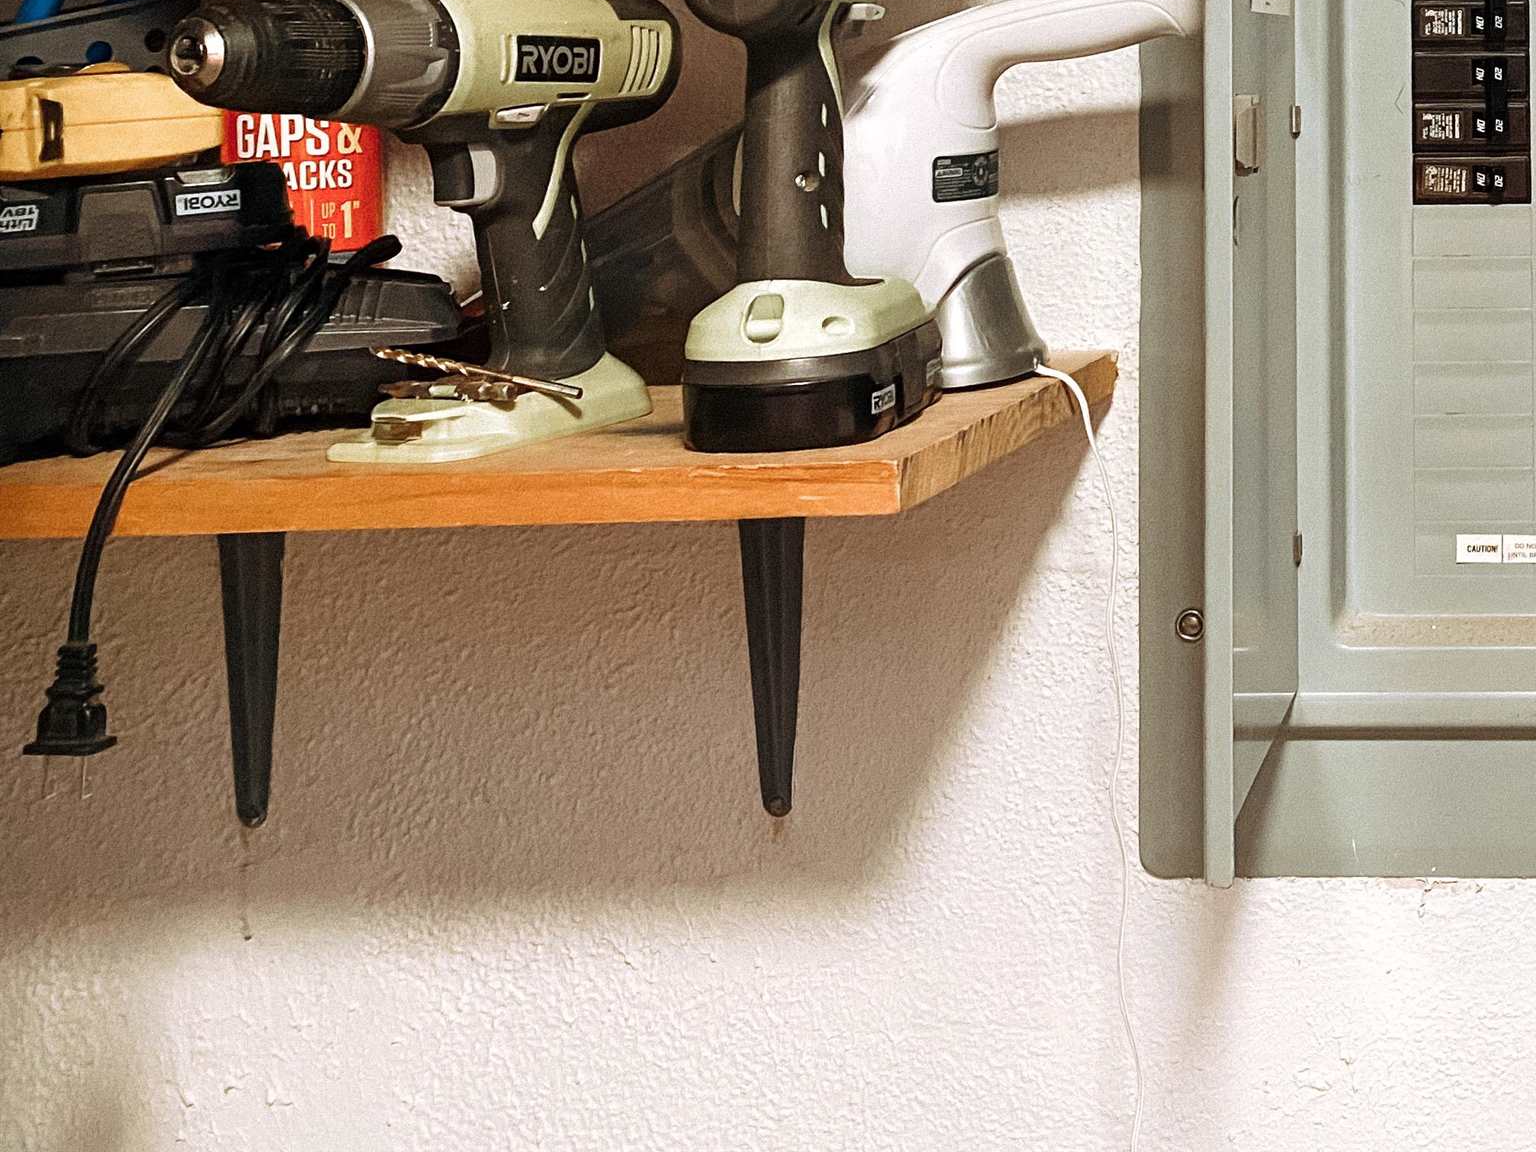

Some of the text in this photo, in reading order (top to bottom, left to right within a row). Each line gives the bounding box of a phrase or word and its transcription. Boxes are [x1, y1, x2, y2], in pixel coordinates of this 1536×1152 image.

[521, 44, 595, 75] RYOBI
[237, 114, 363, 159] GAPS &
[282, 159, 353, 191] ACKS
[184, 194, 239, 211] RYOBI
[322, 202, 335, 218] UP
[322, 223, 335, 239] TO
[341, 200, 360, 238] 1"
